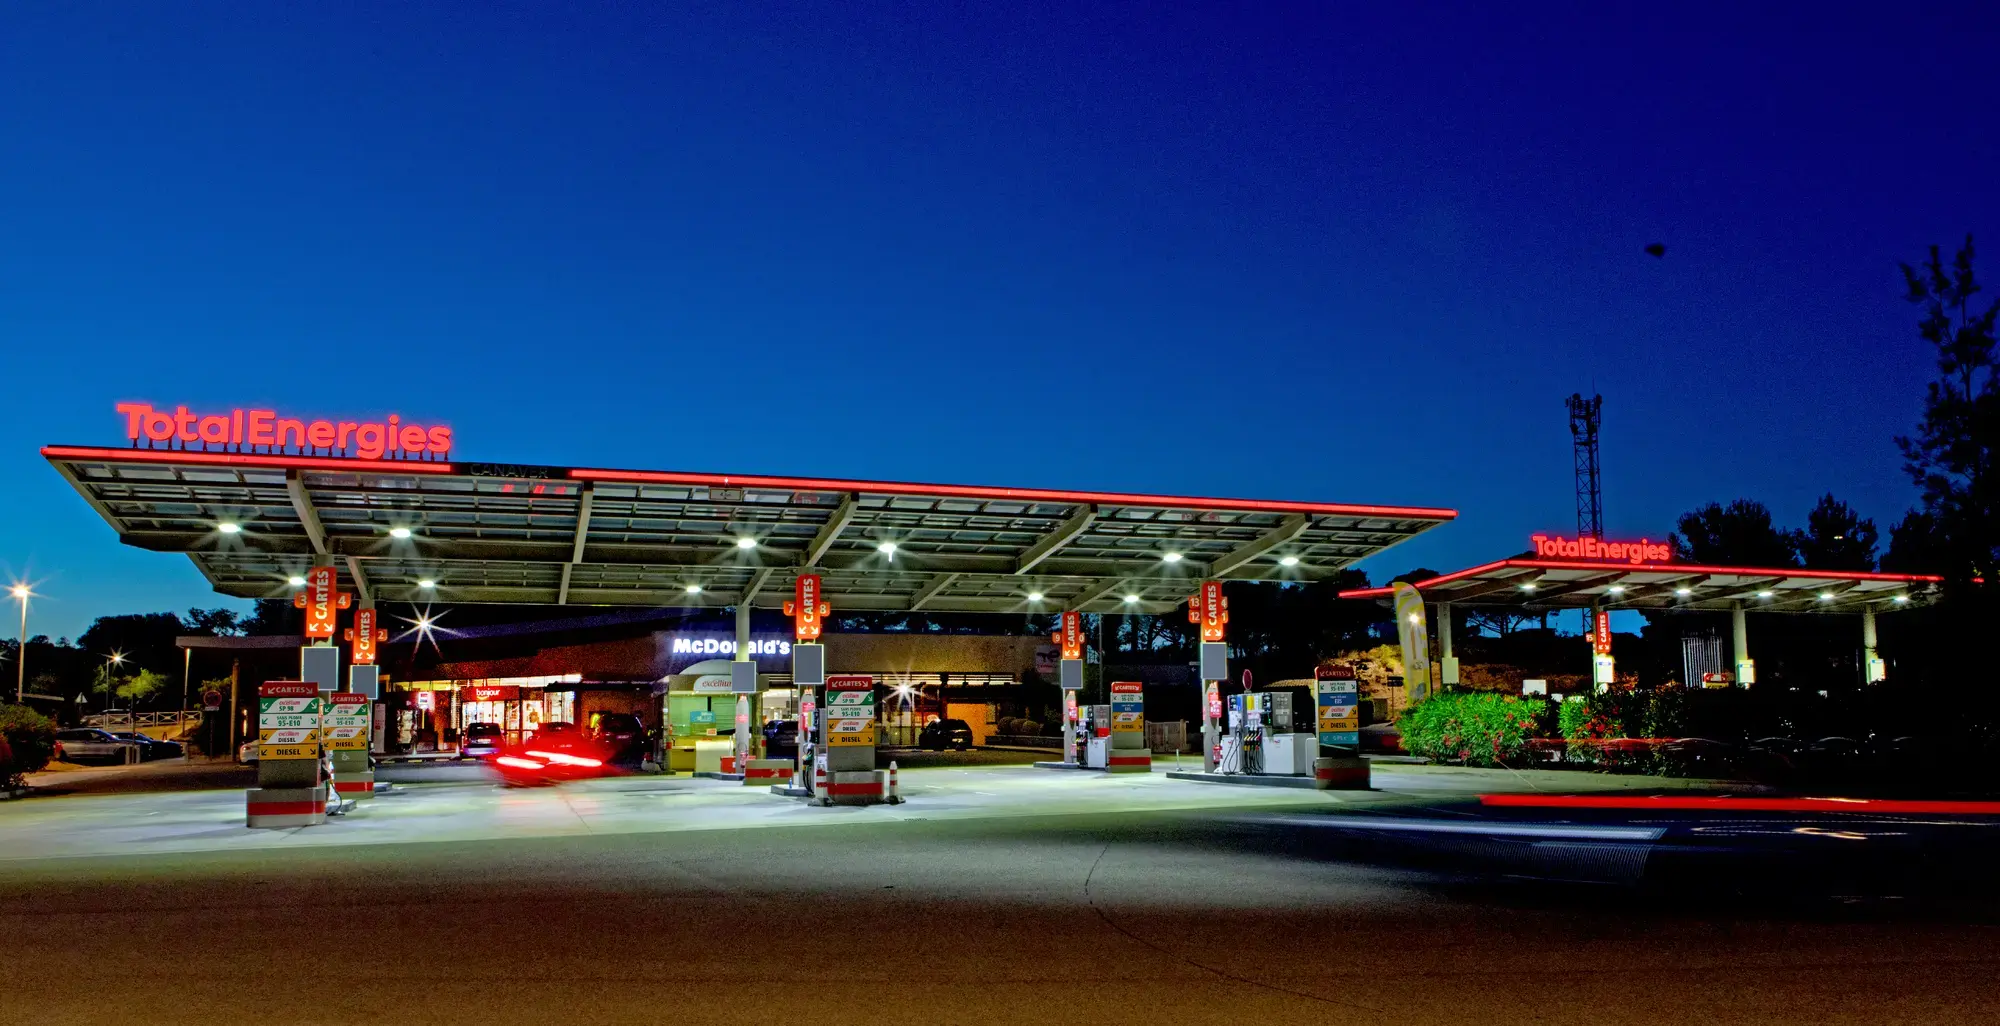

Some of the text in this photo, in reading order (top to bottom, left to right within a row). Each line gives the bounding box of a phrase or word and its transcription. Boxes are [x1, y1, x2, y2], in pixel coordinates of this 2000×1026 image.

[117, 403, 451, 459] TotalEnergies
[470, 464, 549, 478] CANAVER
[1532, 535, 1669, 564] TotalEnergies
[299, 595, 307, 606] 3
[315, 571, 329, 620] CARTES
[337, 596, 346, 606] 4
[804, 579, 814, 623] CARTES
[1190, 598, 1200, 606] 13
[1207, 585, 1217, 625] CARTES
[788, 604, 795, 614] 7
[819, 604, 827, 614] 8
[1190, 612, 1200, 621] 12
[359, 612, 370, 650] CARTES
[1067, 615, 1075, 647] CARTES
[1599, 614, 1607, 643] CARTES
[348, 631, 354, 639] 1
[377, 631, 385, 640] 2
[1055, 634, 1061, 642] 9
[475, 687, 501, 697] bonjour
